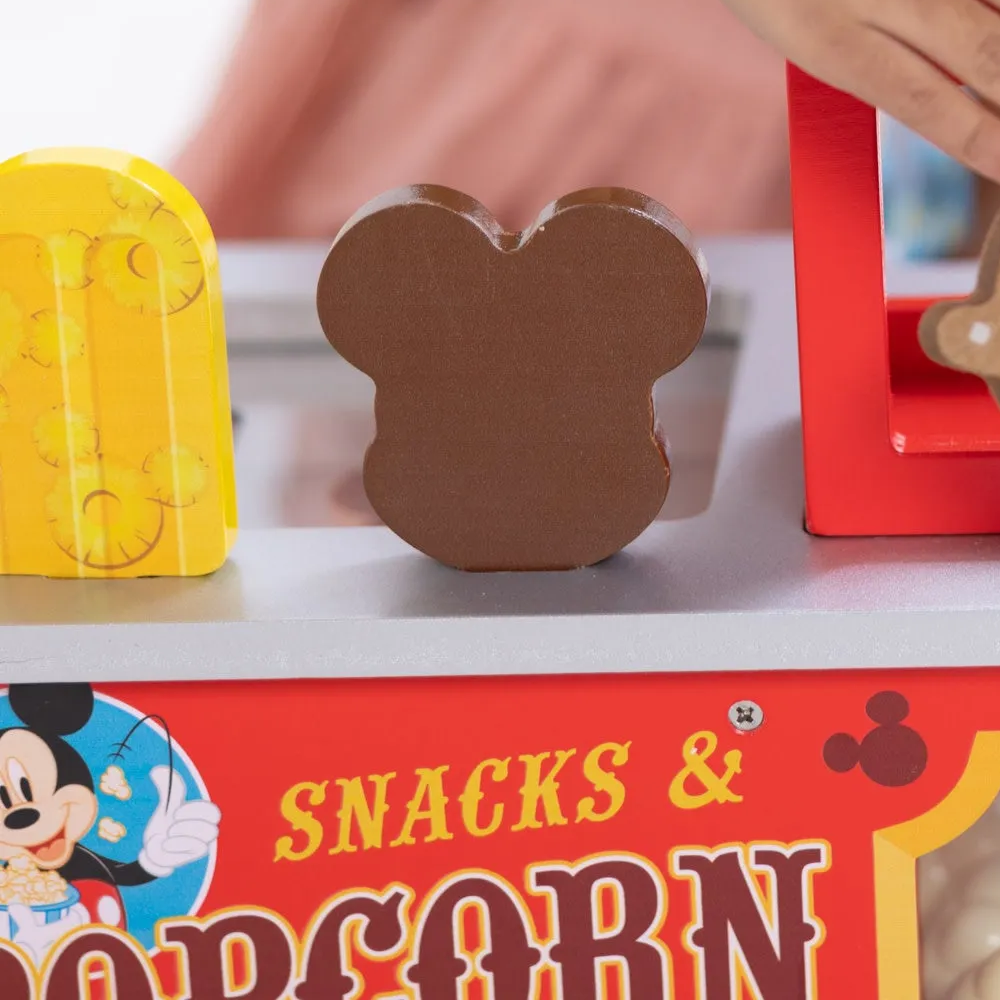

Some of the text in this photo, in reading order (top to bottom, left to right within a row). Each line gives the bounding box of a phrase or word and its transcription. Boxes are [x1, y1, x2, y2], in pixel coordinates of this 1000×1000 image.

[273, 730, 744, 862] SNACKS &
[0, 840, 832, 1000] PCORN
